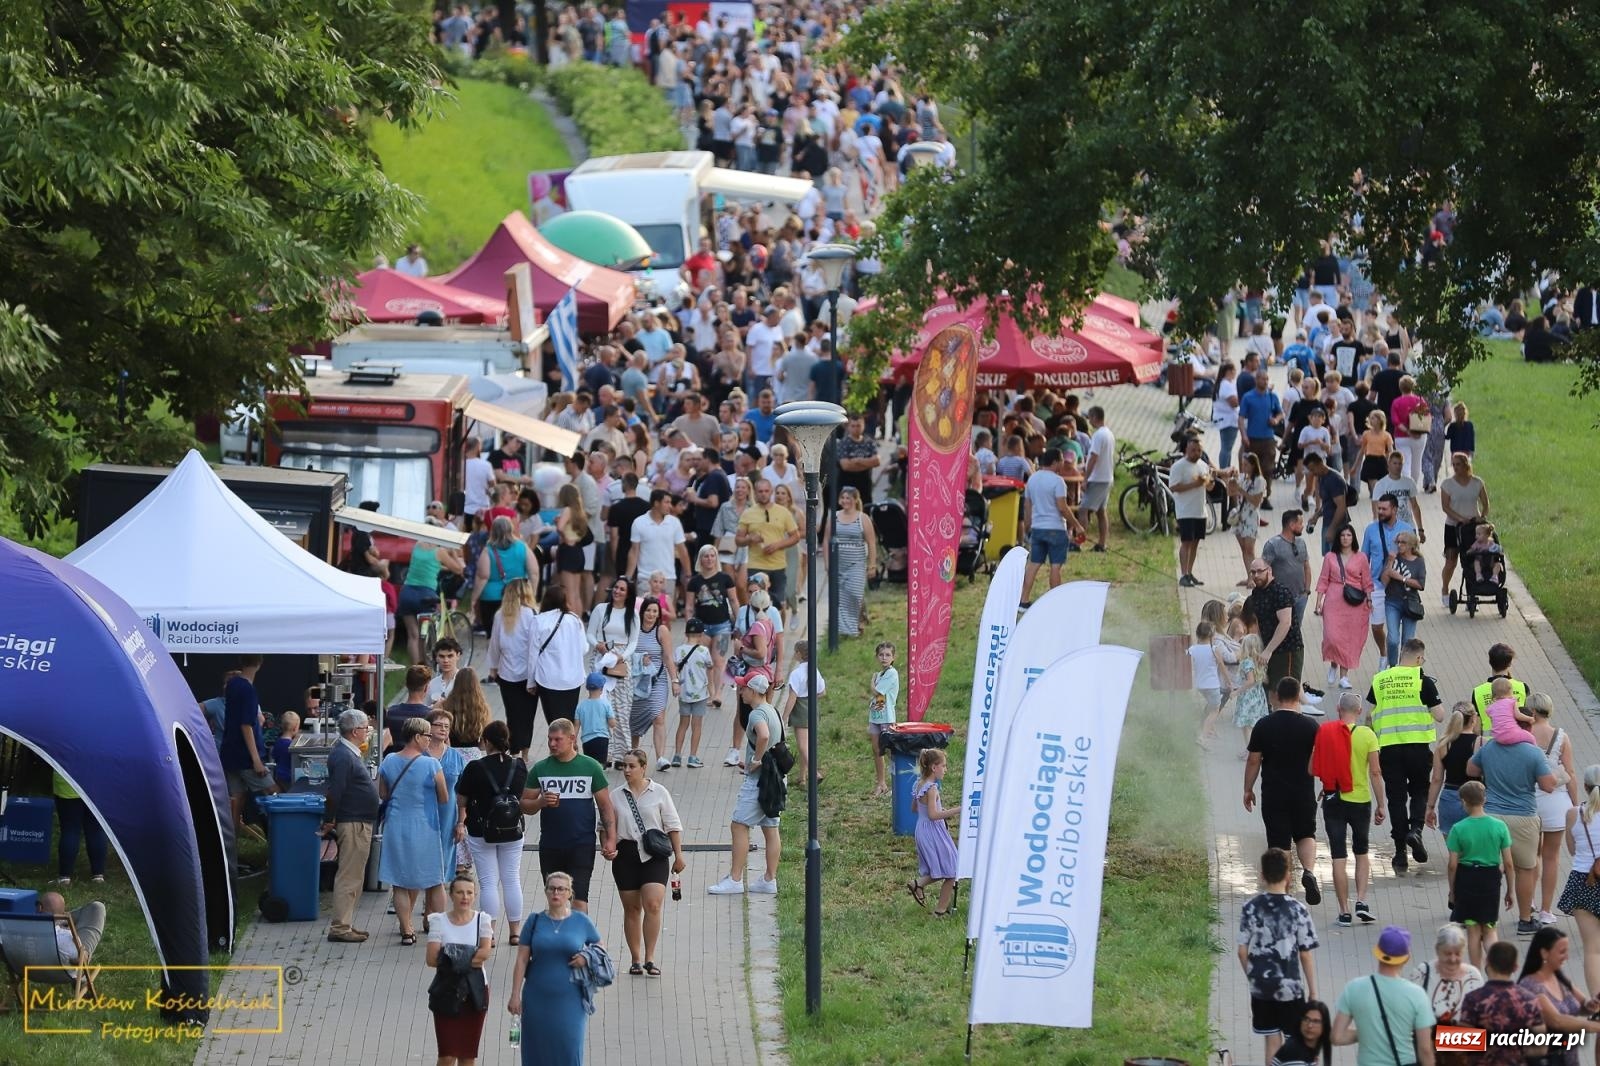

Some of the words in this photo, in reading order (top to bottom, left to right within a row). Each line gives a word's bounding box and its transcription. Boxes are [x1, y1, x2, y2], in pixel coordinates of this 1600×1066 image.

[1034, 369, 1120, 386] RACIBORSKIE
[167, 621, 239, 634] Wodociągi
[910, 560, 918, 636] PIEROGI
[168, 634, 240, 644] Raciborskie
[977, 625, 1000, 776] Wodociągi
[1017, 733, 1066, 907] Wodociągi
[1050, 736, 1091, 907] Raciborskie
